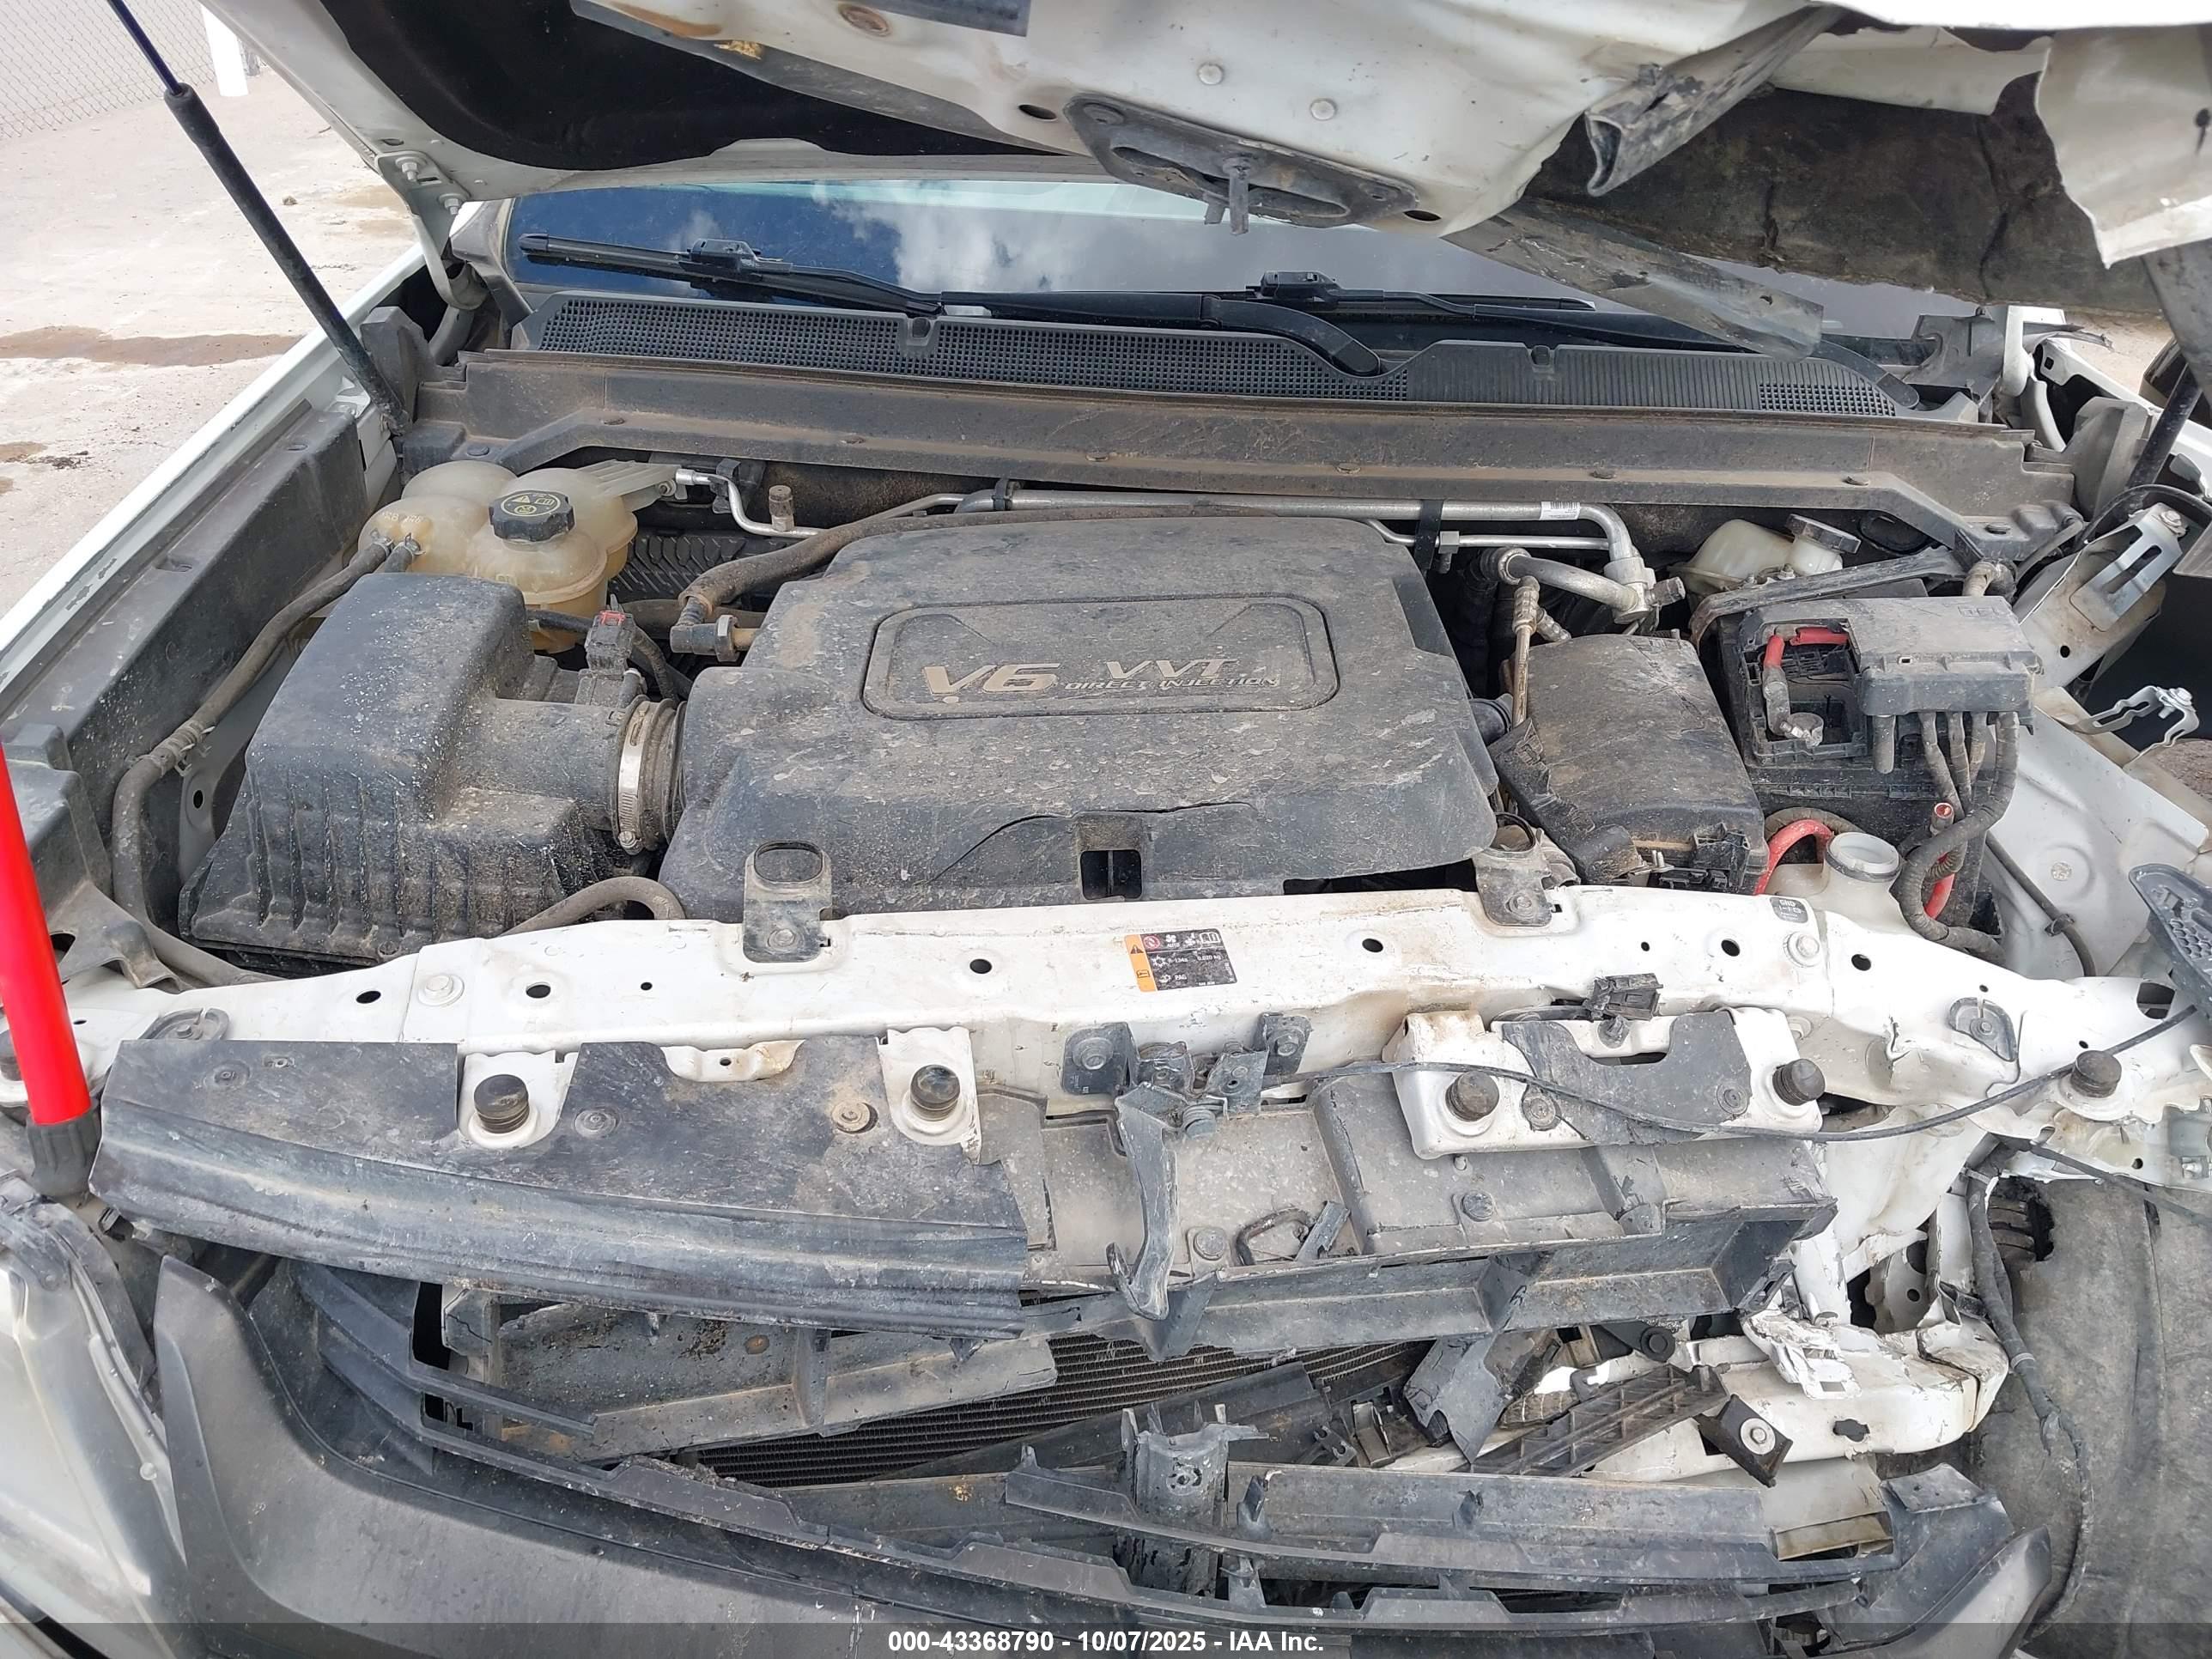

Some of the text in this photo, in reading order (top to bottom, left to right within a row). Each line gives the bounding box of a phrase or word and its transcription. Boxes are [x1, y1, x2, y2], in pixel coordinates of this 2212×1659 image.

[924, 659, 1238, 693] V6 VVT
[1065, 677, 1279, 690] DIRECT INJECTION
